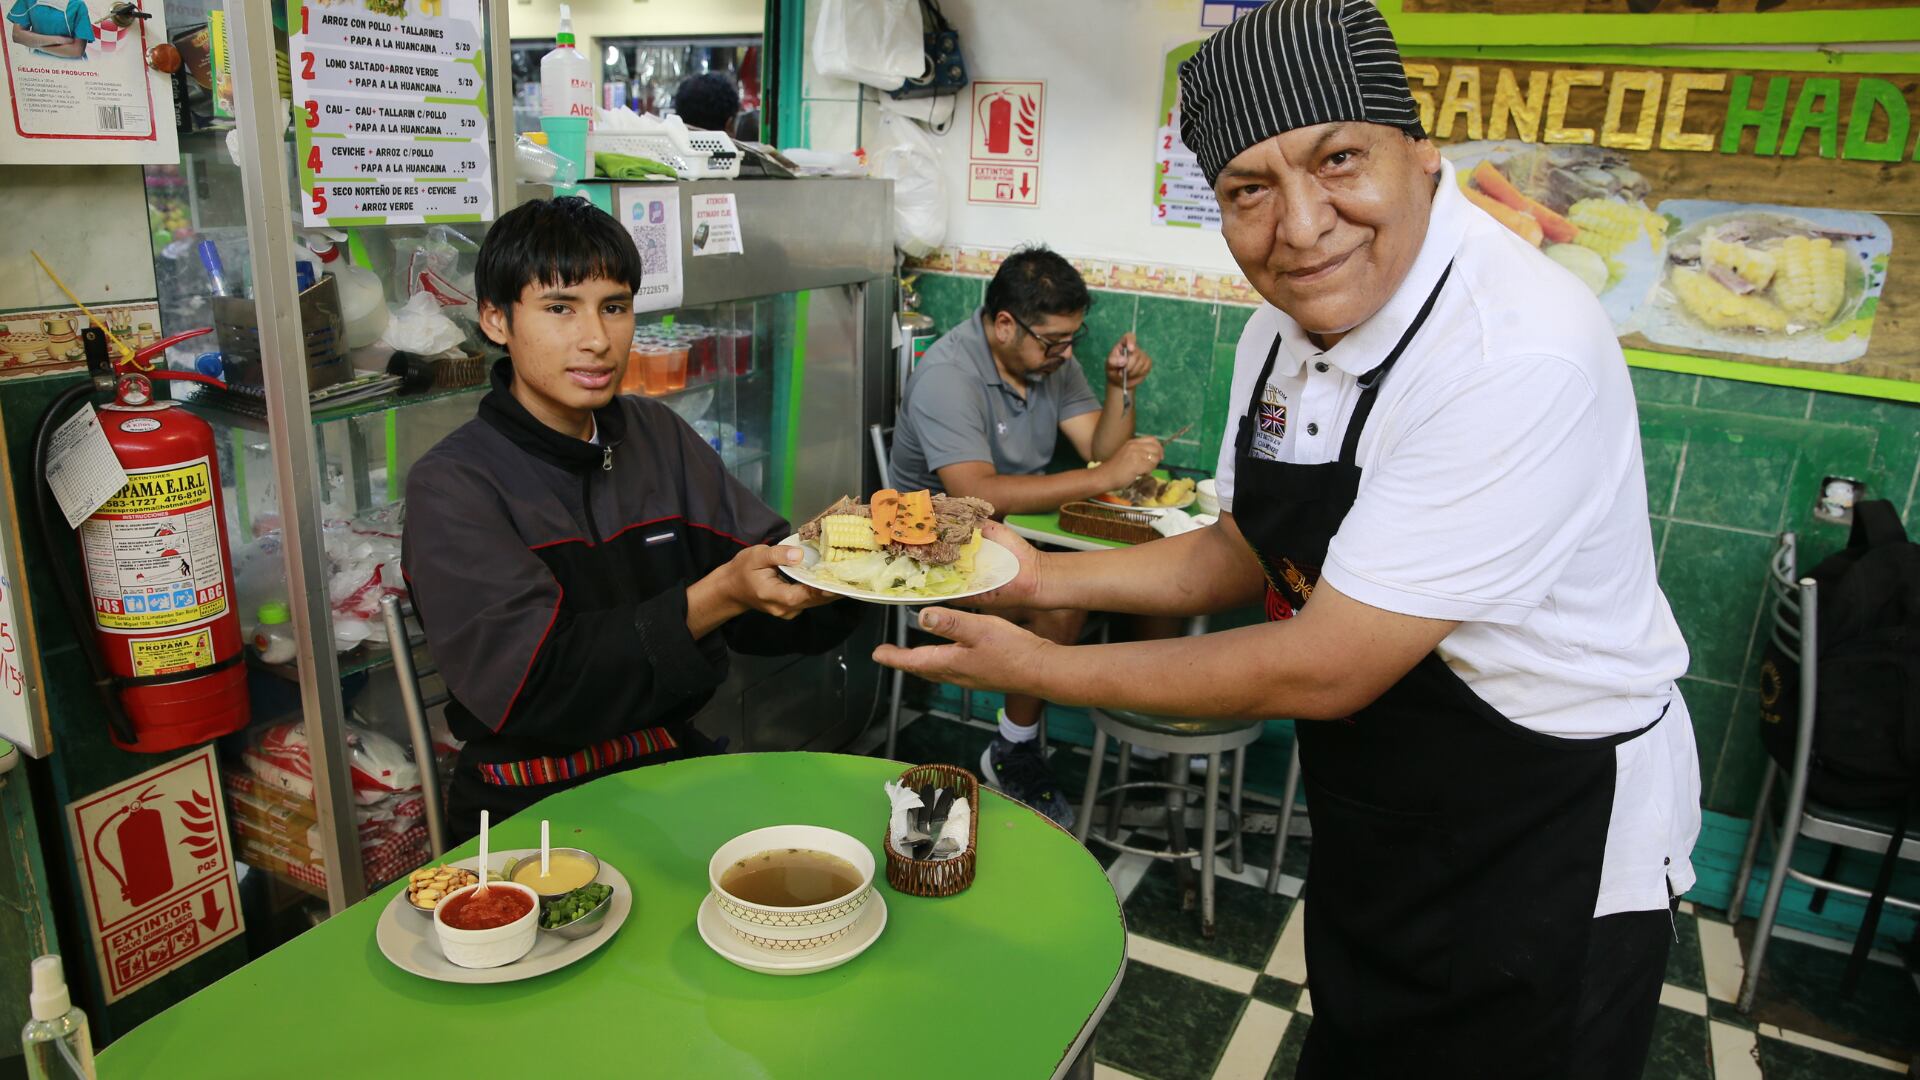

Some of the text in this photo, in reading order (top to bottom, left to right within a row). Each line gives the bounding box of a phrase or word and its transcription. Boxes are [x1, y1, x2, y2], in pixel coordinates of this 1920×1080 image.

[300, 6, 309, 35] 1
[322, 15, 348, 27] ARROZ
[351, 19, 366, 29] CON
[368, 21, 391, 32] POLLO
[401, 26, 444, 39] TALLARINES
[350, 35, 372, 46] PAPA
[375, 38, 381, 47] A
[383, 39, 393, 48] LA
[395, 40, 436, 54] HUANCAINA
[455, 42, 471, 52] S/20
[300, 52, 316, 80] 2
[325, 58, 346, 69] LOMO
[416, 66, 439, 77] VERDE
[355, 78, 378, 88] PAPA
[380, 80, 387, 89] A
[388, 81, 399, 90] LA
[400, 82, 441, 93] HUANCAINA
[458, 77, 473, 87] S/20
[304, 100, 320, 128] 3
[326, 104, 342, 114] CAU
[378, 108, 415, 118] TALLARIN
[417, 109, 447, 120] C/POLLO
[1167, 112, 1172, 127] 1
[1402, 62, 1920, 163] SANCOCHAD
[355, 123, 378, 133] PAPA
[380, 124, 387, 133] A
[388, 125, 399, 134] LA
[400, 125, 441, 135] HUANCAINA
[461, 119, 476, 128] S/20
[1164, 135, 1172, 149] 2
[307, 145, 323, 174] 4
[332, 147, 365, 156] CEVICHE
[376, 148, 400, 157] ARROZ
[403, 148, 434, 158] C/POLLO
[361, 164, 383, 173] PAPA
[385, 164, 392, 173] A
[393, 164, 403, 173] LA
[405, 164, 447, 173] HUANCAINA
[461, 161, 476, 169] S/25
[1161, 160, 1170, 174] 3
[1158, 183, 1167, 196] 4
[312, 187, 328, 216] 5
[332, 187, 353, 196] SECO
[355, 184, 390, 196] NORTEÑO
[392, 187, 402, 196] DE
[404, 187, 418, 195] RES
[427, 186, 456, 195] CEVICHE
[362, 203, 387, 212] ARROZ
[389, 202, 414, 211] VERDE
[463, 196, 478, 204] S/25
[1158, 204, 1166, 218] 5
[638, 284, 669, 295] 37228579
[106, 488, 207, 507] 583-1727 476-8104
[96, 585, 222, 613] PQS ABC
[139, 640, 190, 651] PROPAMA
[197, 859, 217, 874] PQS
[112, 901, 192, 949] EXTINTOR
[117, 939, 141, 955] POLVO
[175, 912, 192, 925] SECO
